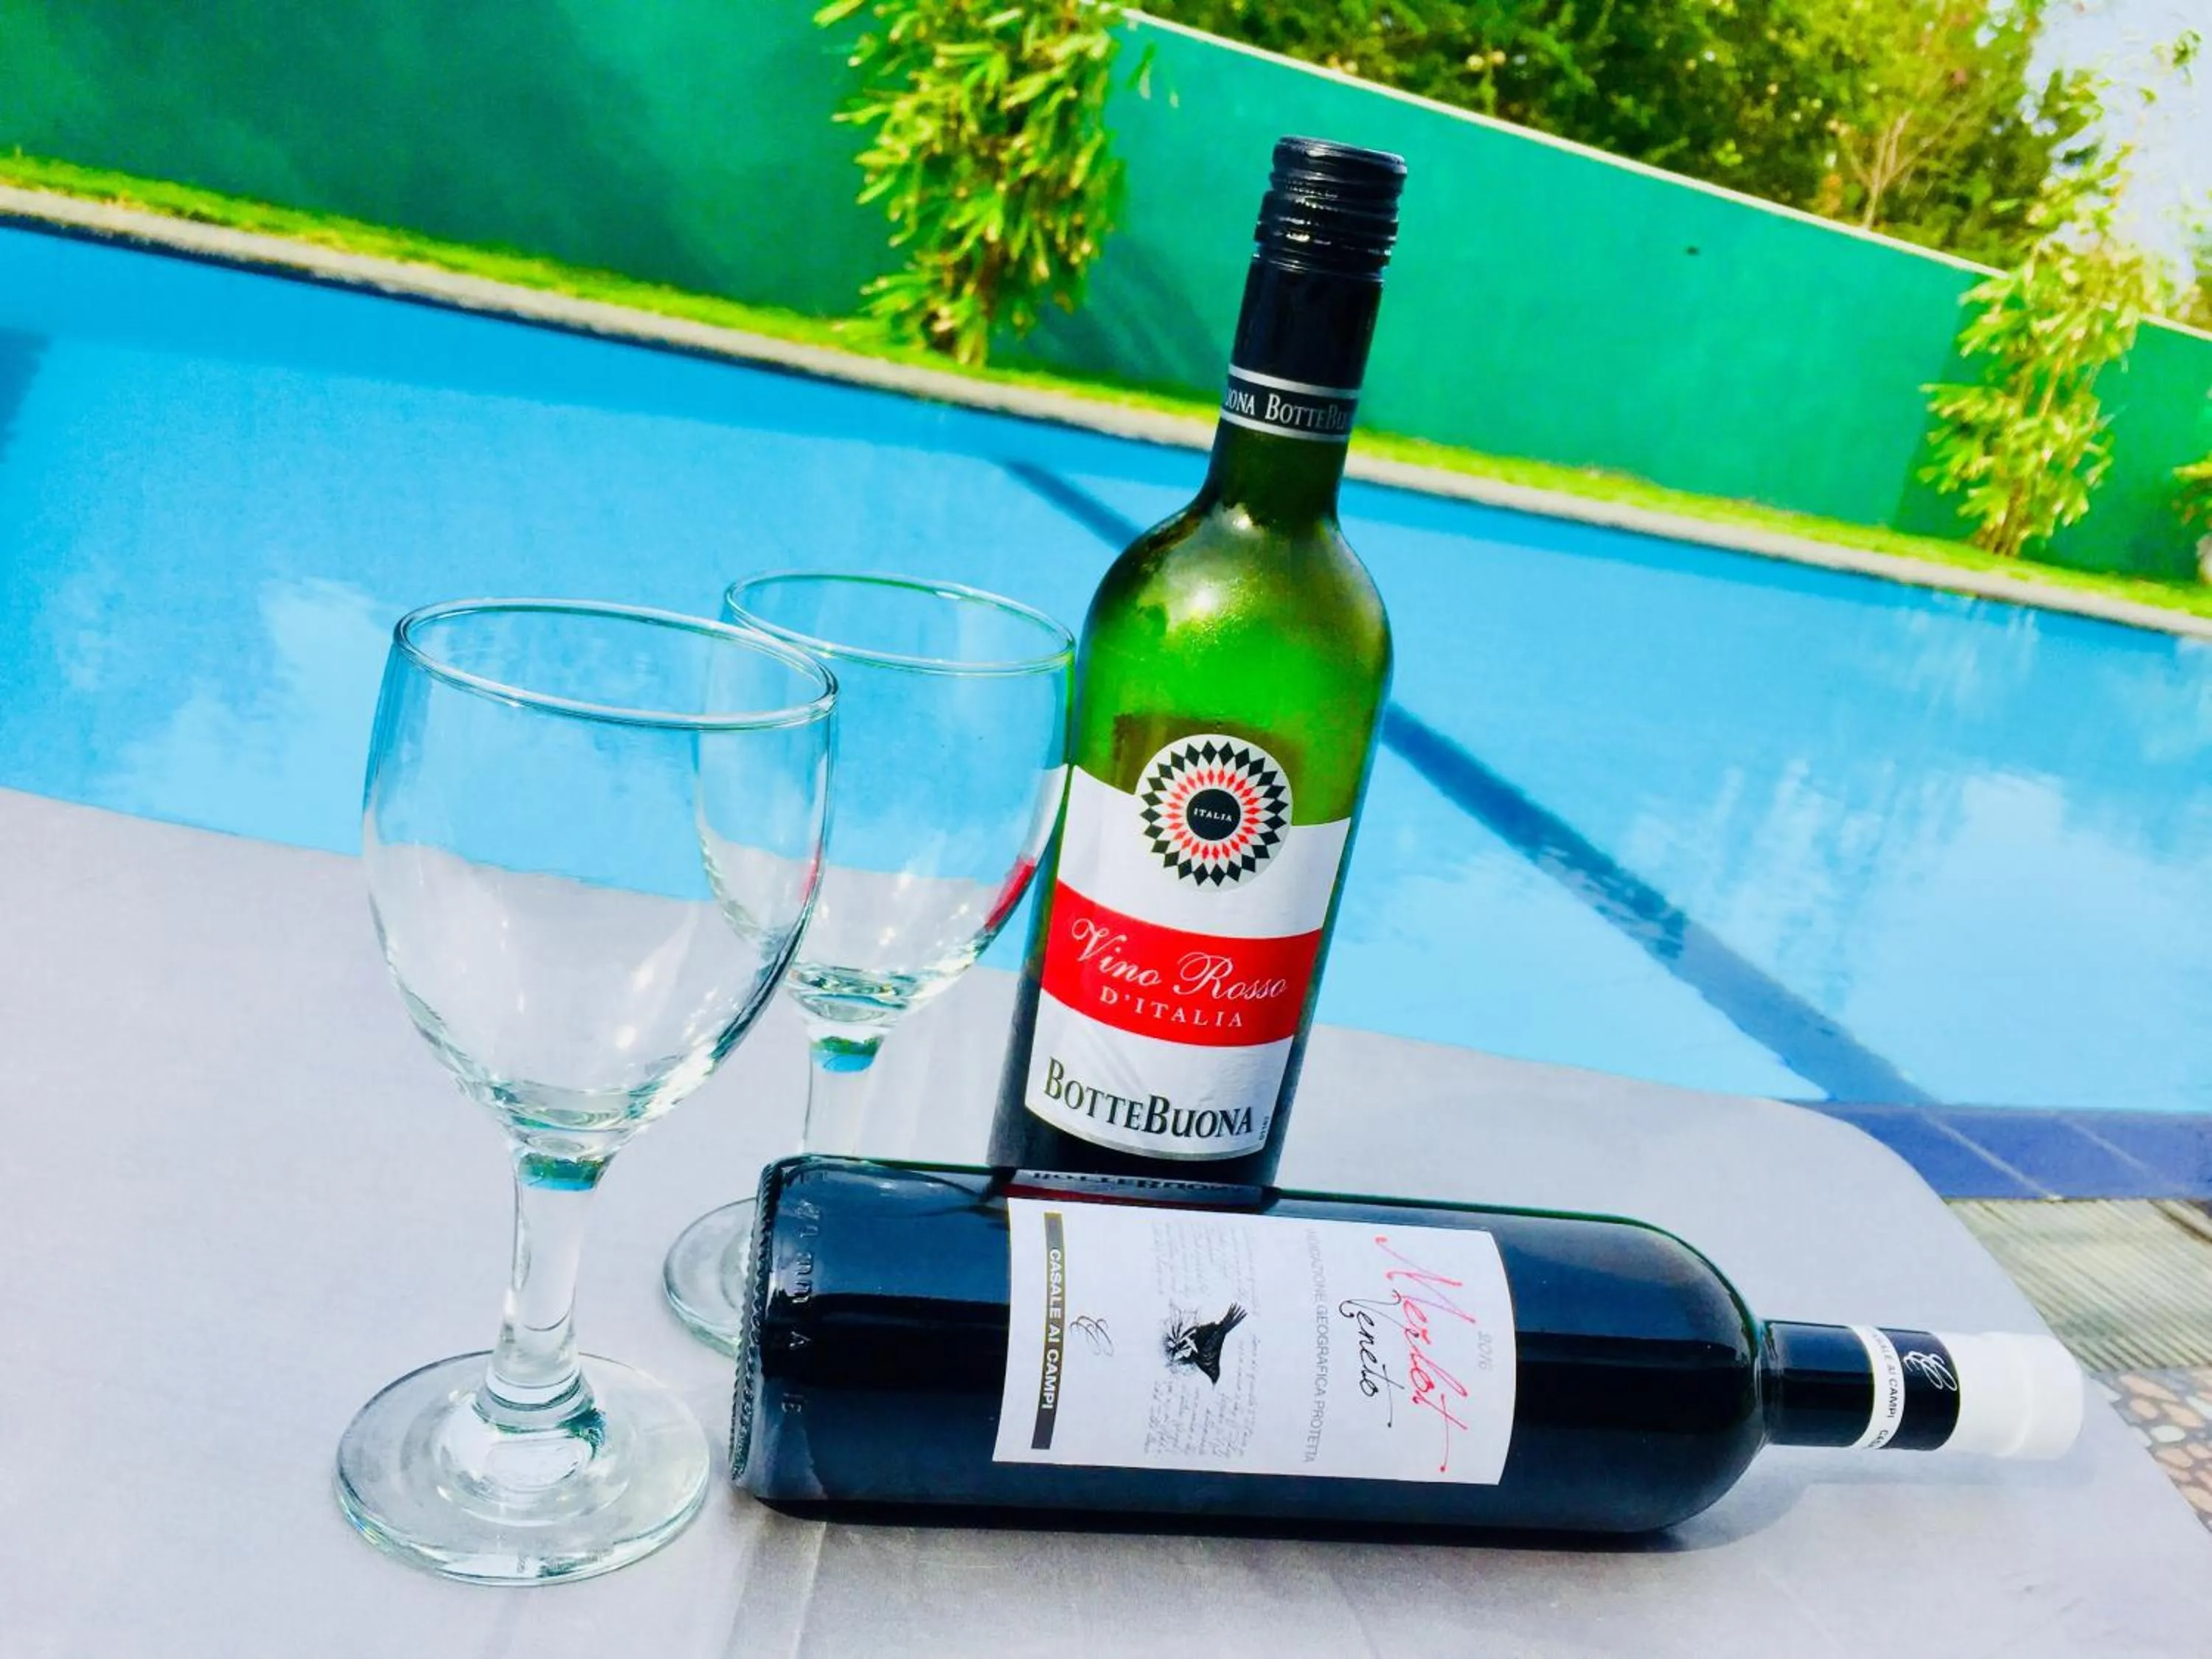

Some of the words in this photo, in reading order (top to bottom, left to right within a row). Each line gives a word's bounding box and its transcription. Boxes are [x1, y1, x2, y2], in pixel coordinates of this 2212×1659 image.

[1193, 807, 1233, 824] ITALIA
[1071, 917, 1163, 988] Vino
[1172, 951, 1289, 1001] Rosso
[1099, 985, 1243, 1028] D'ITALIA
[1048, 1248, 1062, 1319] CASALE
[1048, 1324, 1060, 1343] AI
[1314, 1304, 1329, 1397] GEOGRAFICA
[1339, 1289, 1406, 1427] Veneto
[1375, 1235, 1476, 1472] Merlot
[1042, 1349, 1059, 1410] CAMPI
[1887, 1377, 1899, 1418] CAMPI
[1303, 1399, 1326, 1463] PROTETTA
